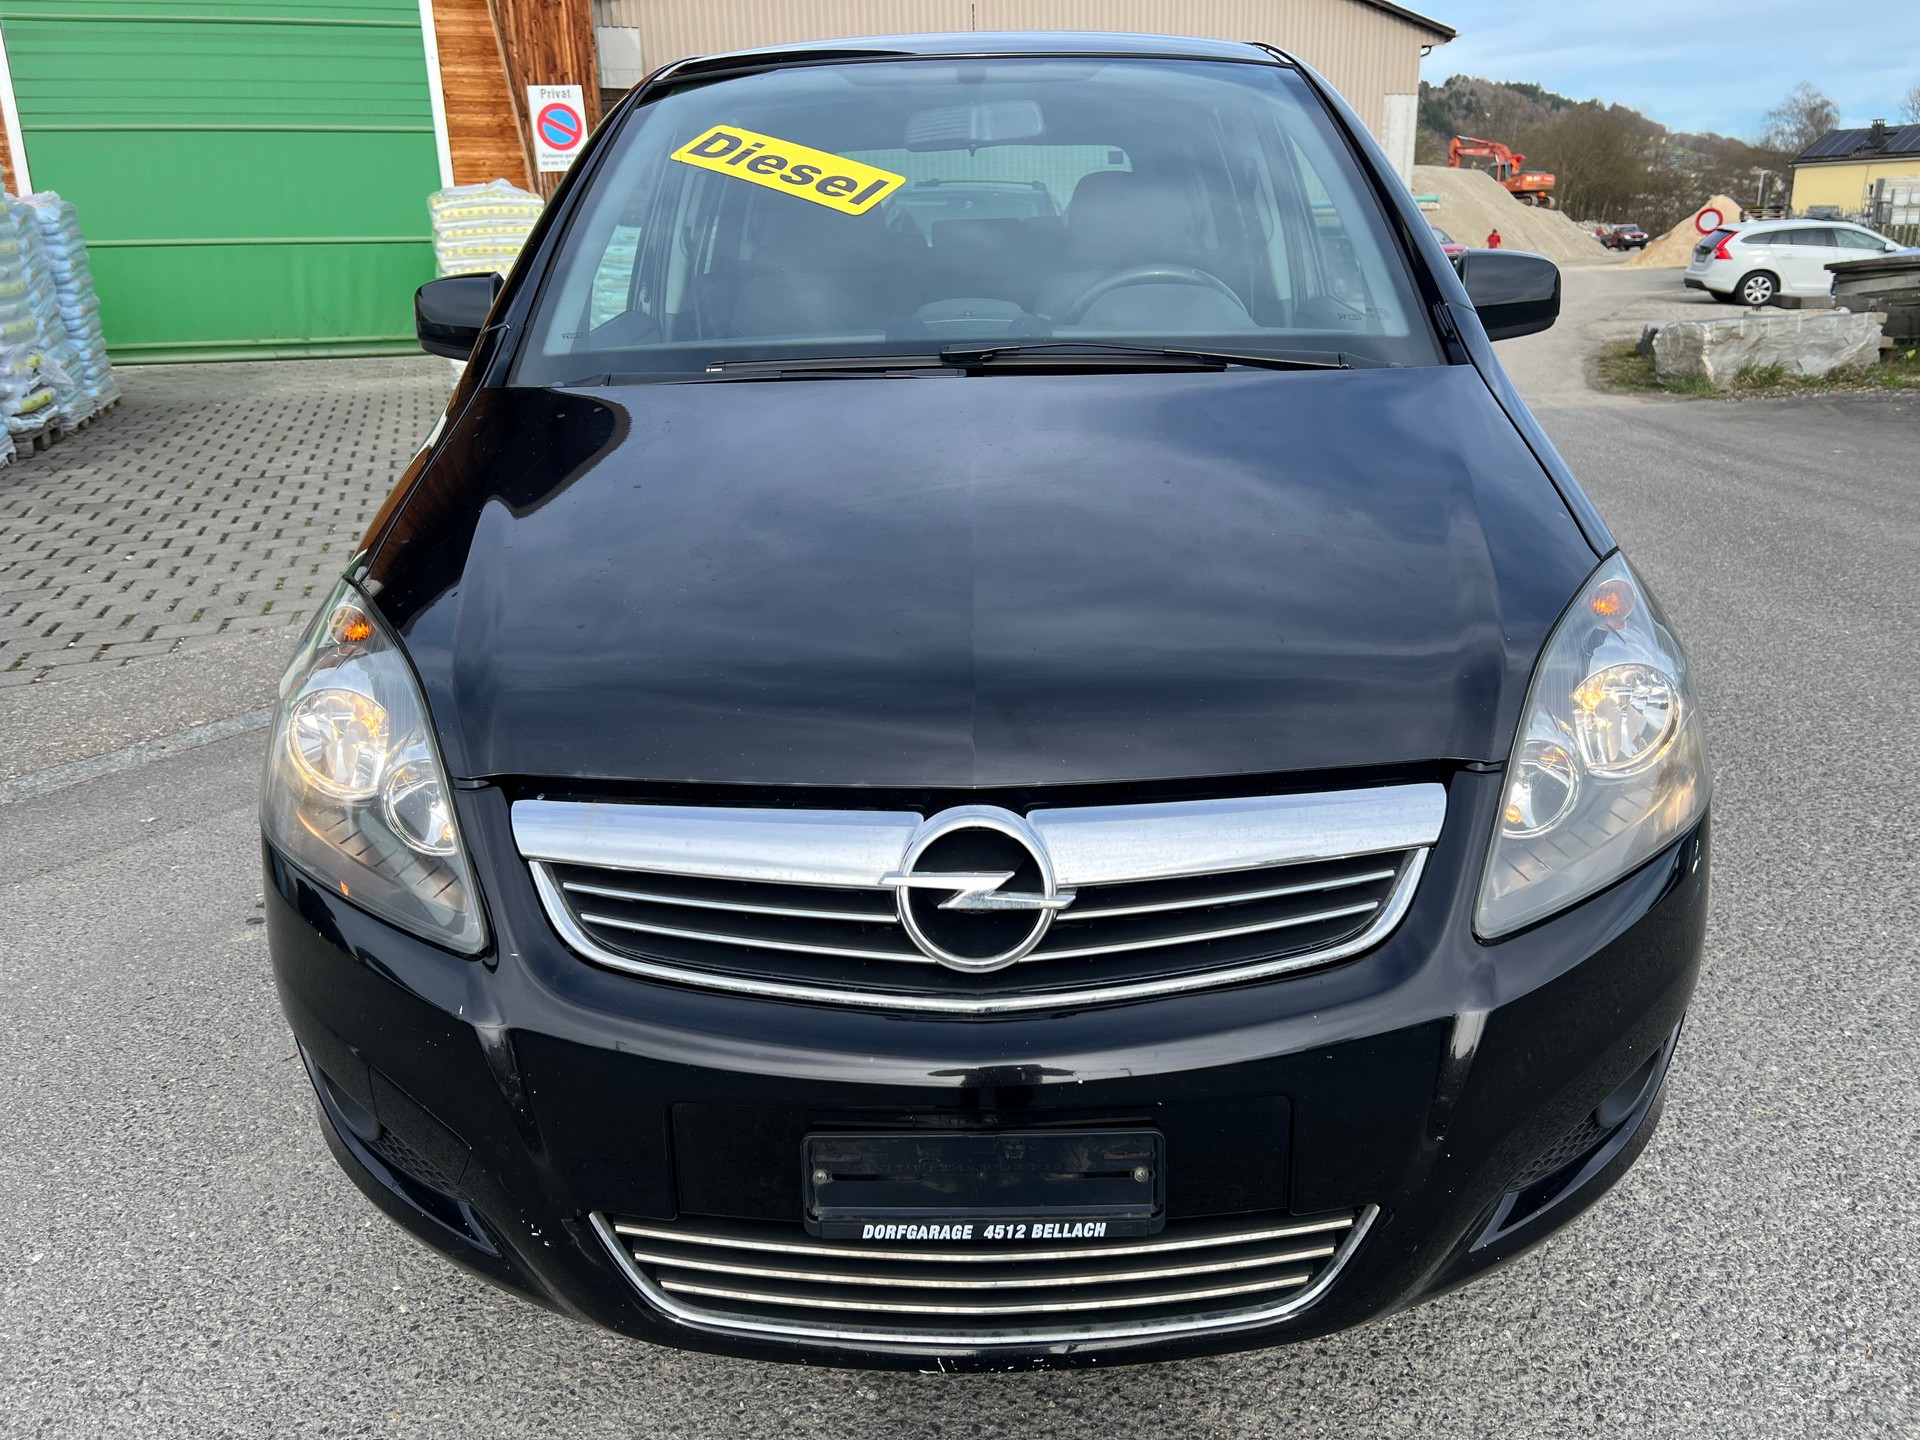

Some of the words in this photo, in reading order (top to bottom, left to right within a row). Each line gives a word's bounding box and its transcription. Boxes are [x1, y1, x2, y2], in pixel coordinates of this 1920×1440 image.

[540, 88, 572, 99] Privat
[686, 131, 890, 206] Diesel
[862, 1223, 974, 1240] DORFGARAGE
[983, 1224, 1026, 1239] 4512
[1031, 1222, 1107, 1239] BELLACH
